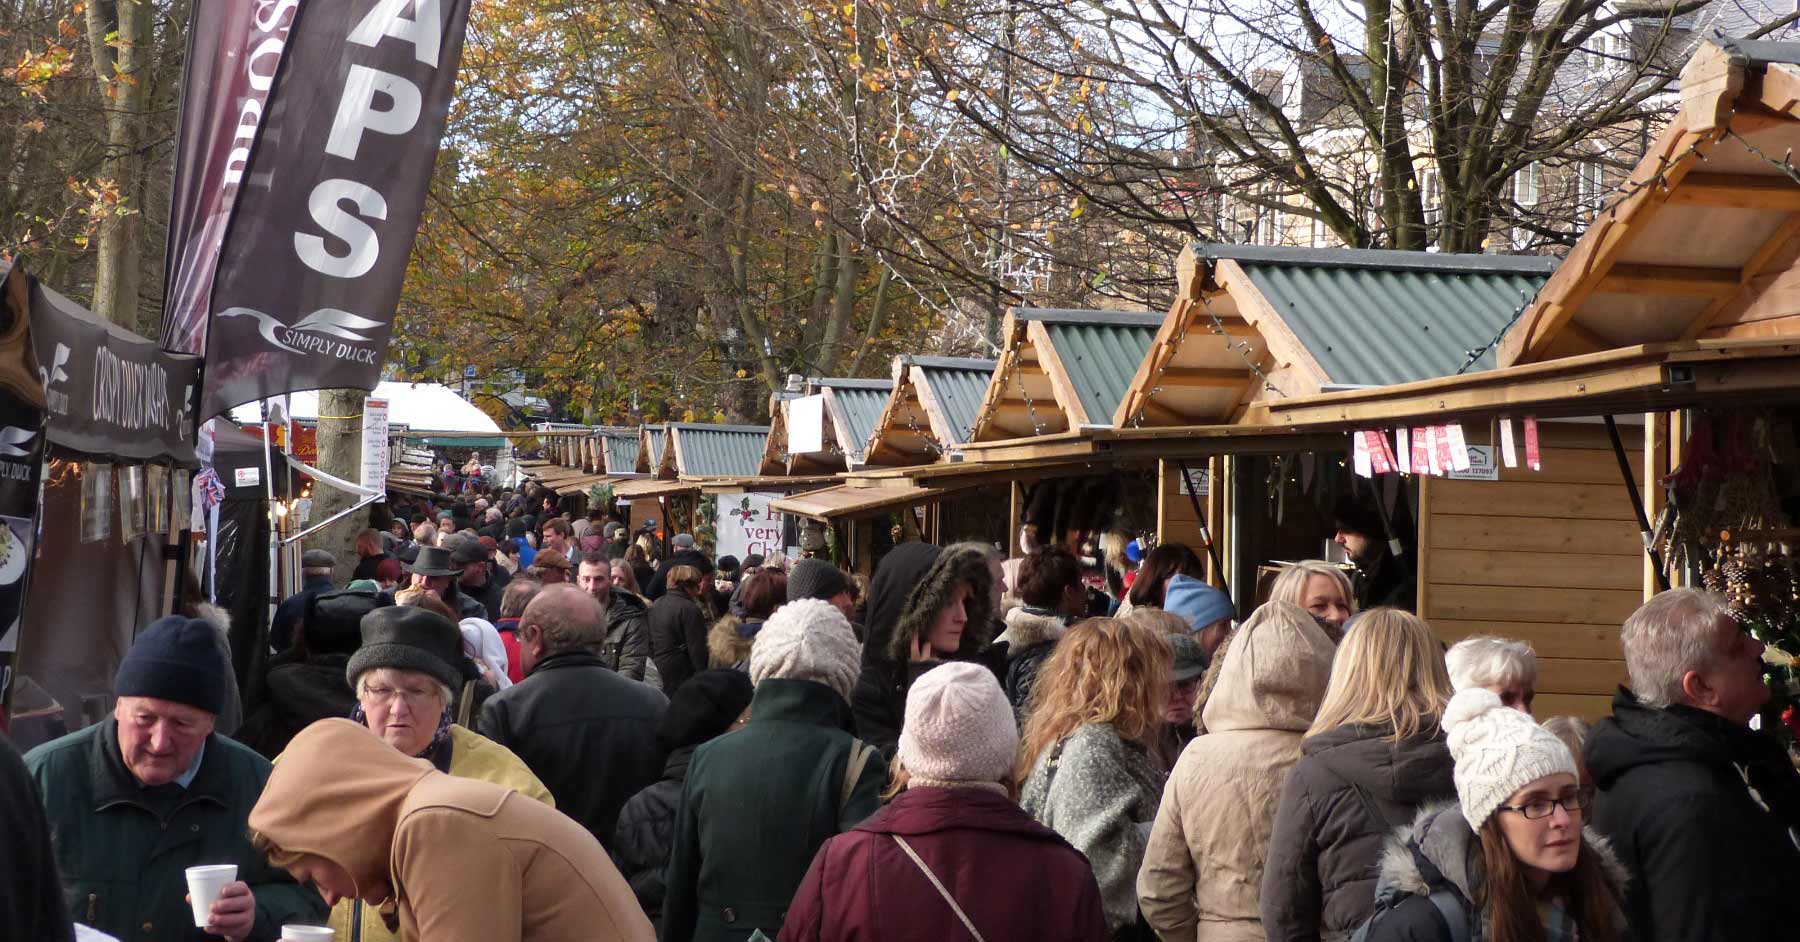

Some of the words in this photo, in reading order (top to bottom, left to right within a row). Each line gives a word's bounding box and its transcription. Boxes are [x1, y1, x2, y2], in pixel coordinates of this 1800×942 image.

[282, 329, 335, 355] SIMPLY
[335, 343, 376, 365] DUCK
[93, 346, 120, 425] CRISPY
[121, 360, 144, 430] DUCK
[11, 462, 32, 480] DUCK
[745, 527, 782, 546] very
